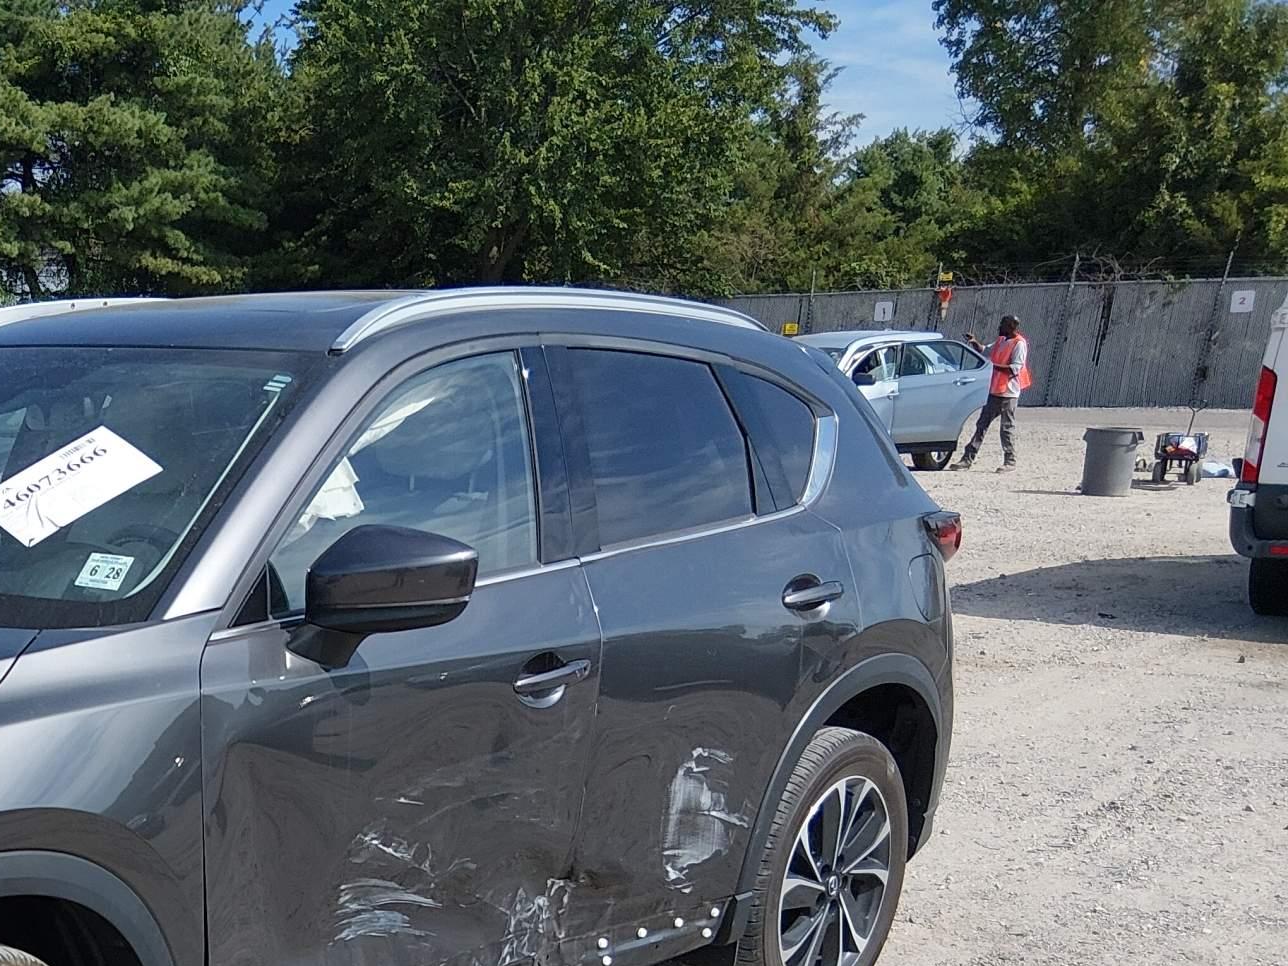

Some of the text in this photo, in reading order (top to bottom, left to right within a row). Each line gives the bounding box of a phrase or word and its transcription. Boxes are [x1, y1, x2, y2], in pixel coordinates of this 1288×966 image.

[1238, 297, 1246, 305] 2
[2, 447, 108, 510] 46073666
[90, 564, 123, 580] 6 28
